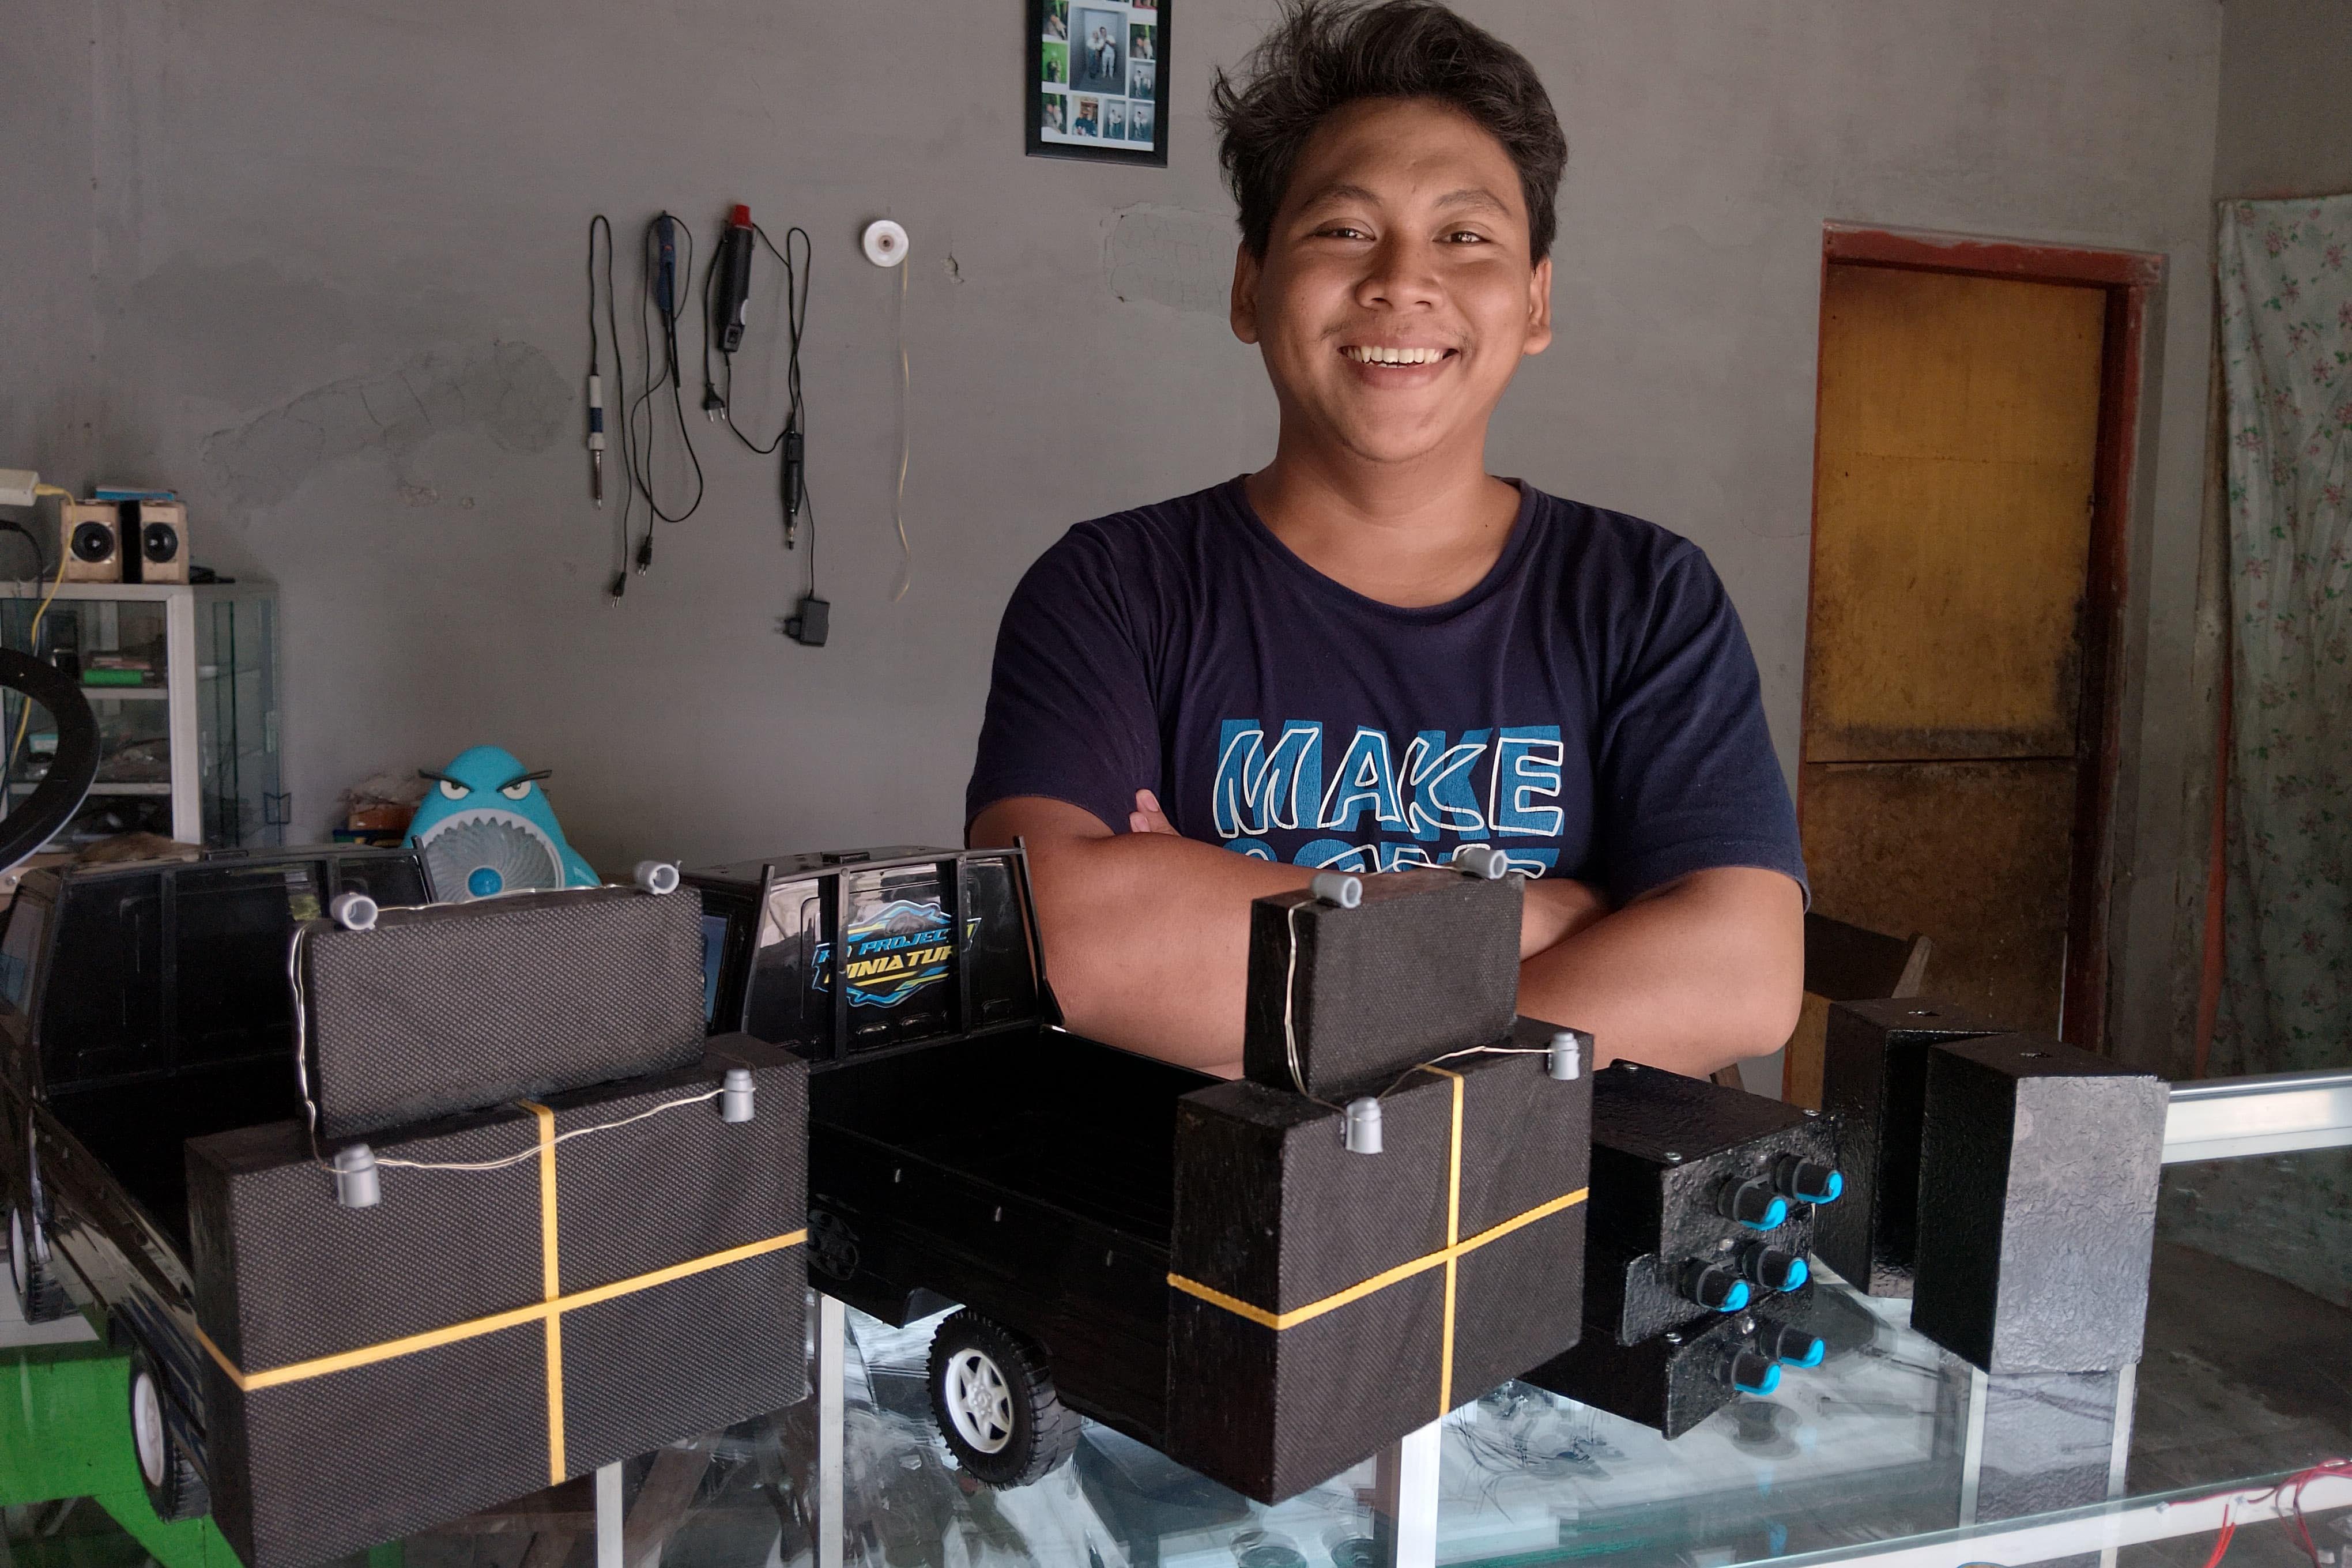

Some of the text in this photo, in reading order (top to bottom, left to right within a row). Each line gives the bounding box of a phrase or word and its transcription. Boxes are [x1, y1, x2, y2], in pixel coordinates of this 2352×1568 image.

[1213, 719, 1564, 840] MAKE
[858, 928, 951, 955] PROJEC
[824, 945, 955, 983] INIATUR
